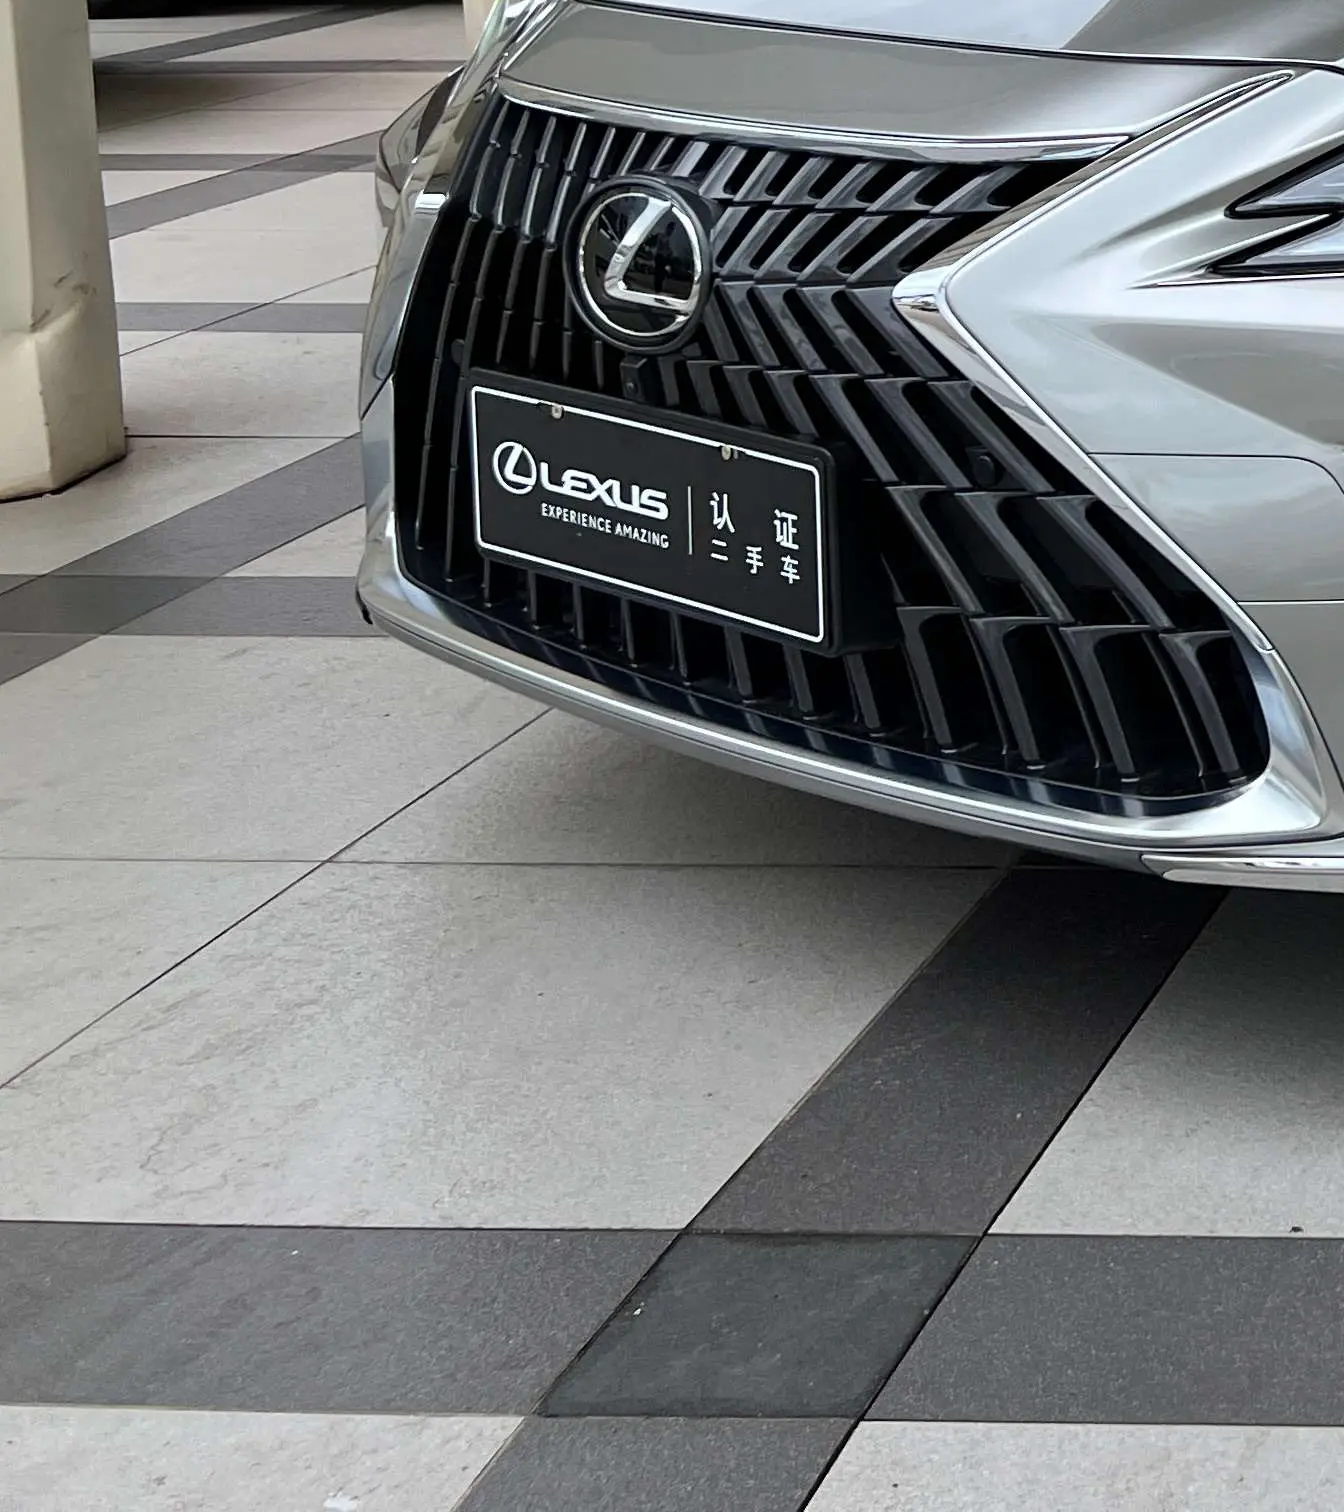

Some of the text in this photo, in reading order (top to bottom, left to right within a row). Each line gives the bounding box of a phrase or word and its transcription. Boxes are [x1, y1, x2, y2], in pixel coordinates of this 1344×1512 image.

[540, 462, 669, 521] LEXUS
[541, 503, 669, 548] EXPERIENCE AMAZING
[710, 492, 799, 550] 认证
[710, 539, 800, 583] 二手车
